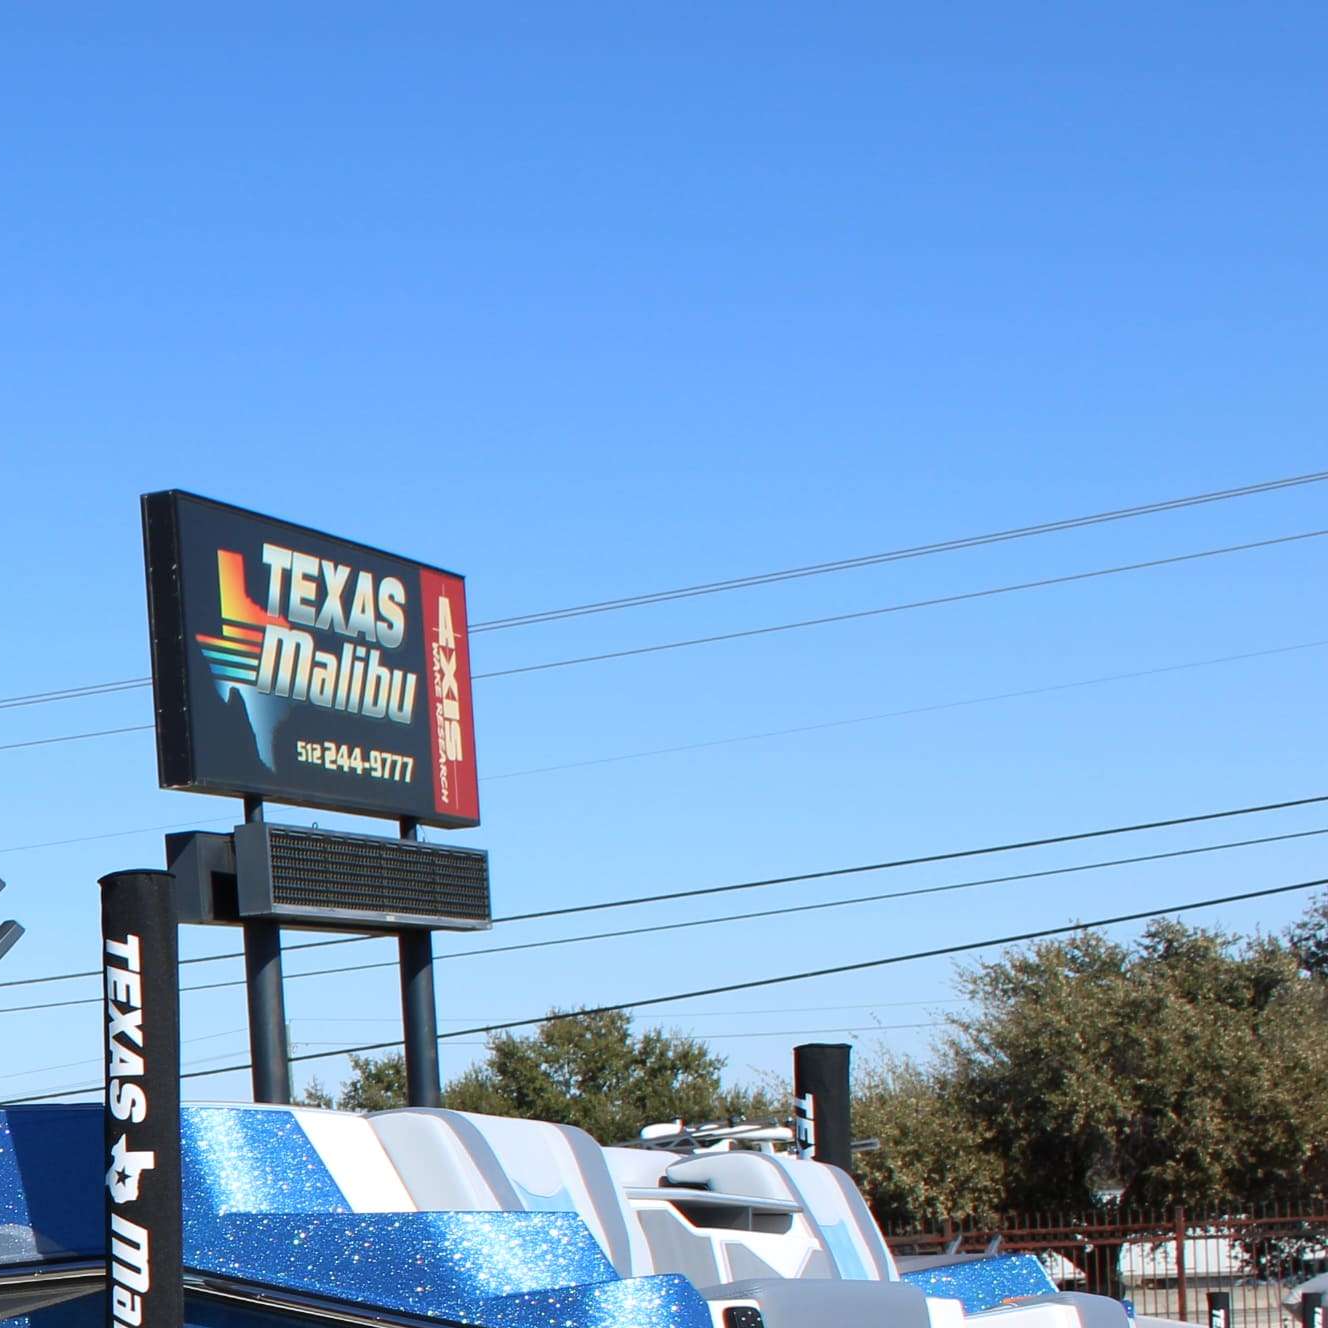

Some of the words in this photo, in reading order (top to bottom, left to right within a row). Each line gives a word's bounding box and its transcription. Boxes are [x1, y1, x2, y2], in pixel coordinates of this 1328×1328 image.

[262, 542, 407, 649] TEXAS
[257, 623, 417, 724] Malibu
[431, 642, 444, 698] WAKE
[438, 596, 464, 762] AXIS
[297, 741, 322, 764] 512
[324, 741, 414, 783] 244-9777
[435, 702, 450, 804] RESEARCH
[105, 934, 147, 1124] TEXAS
